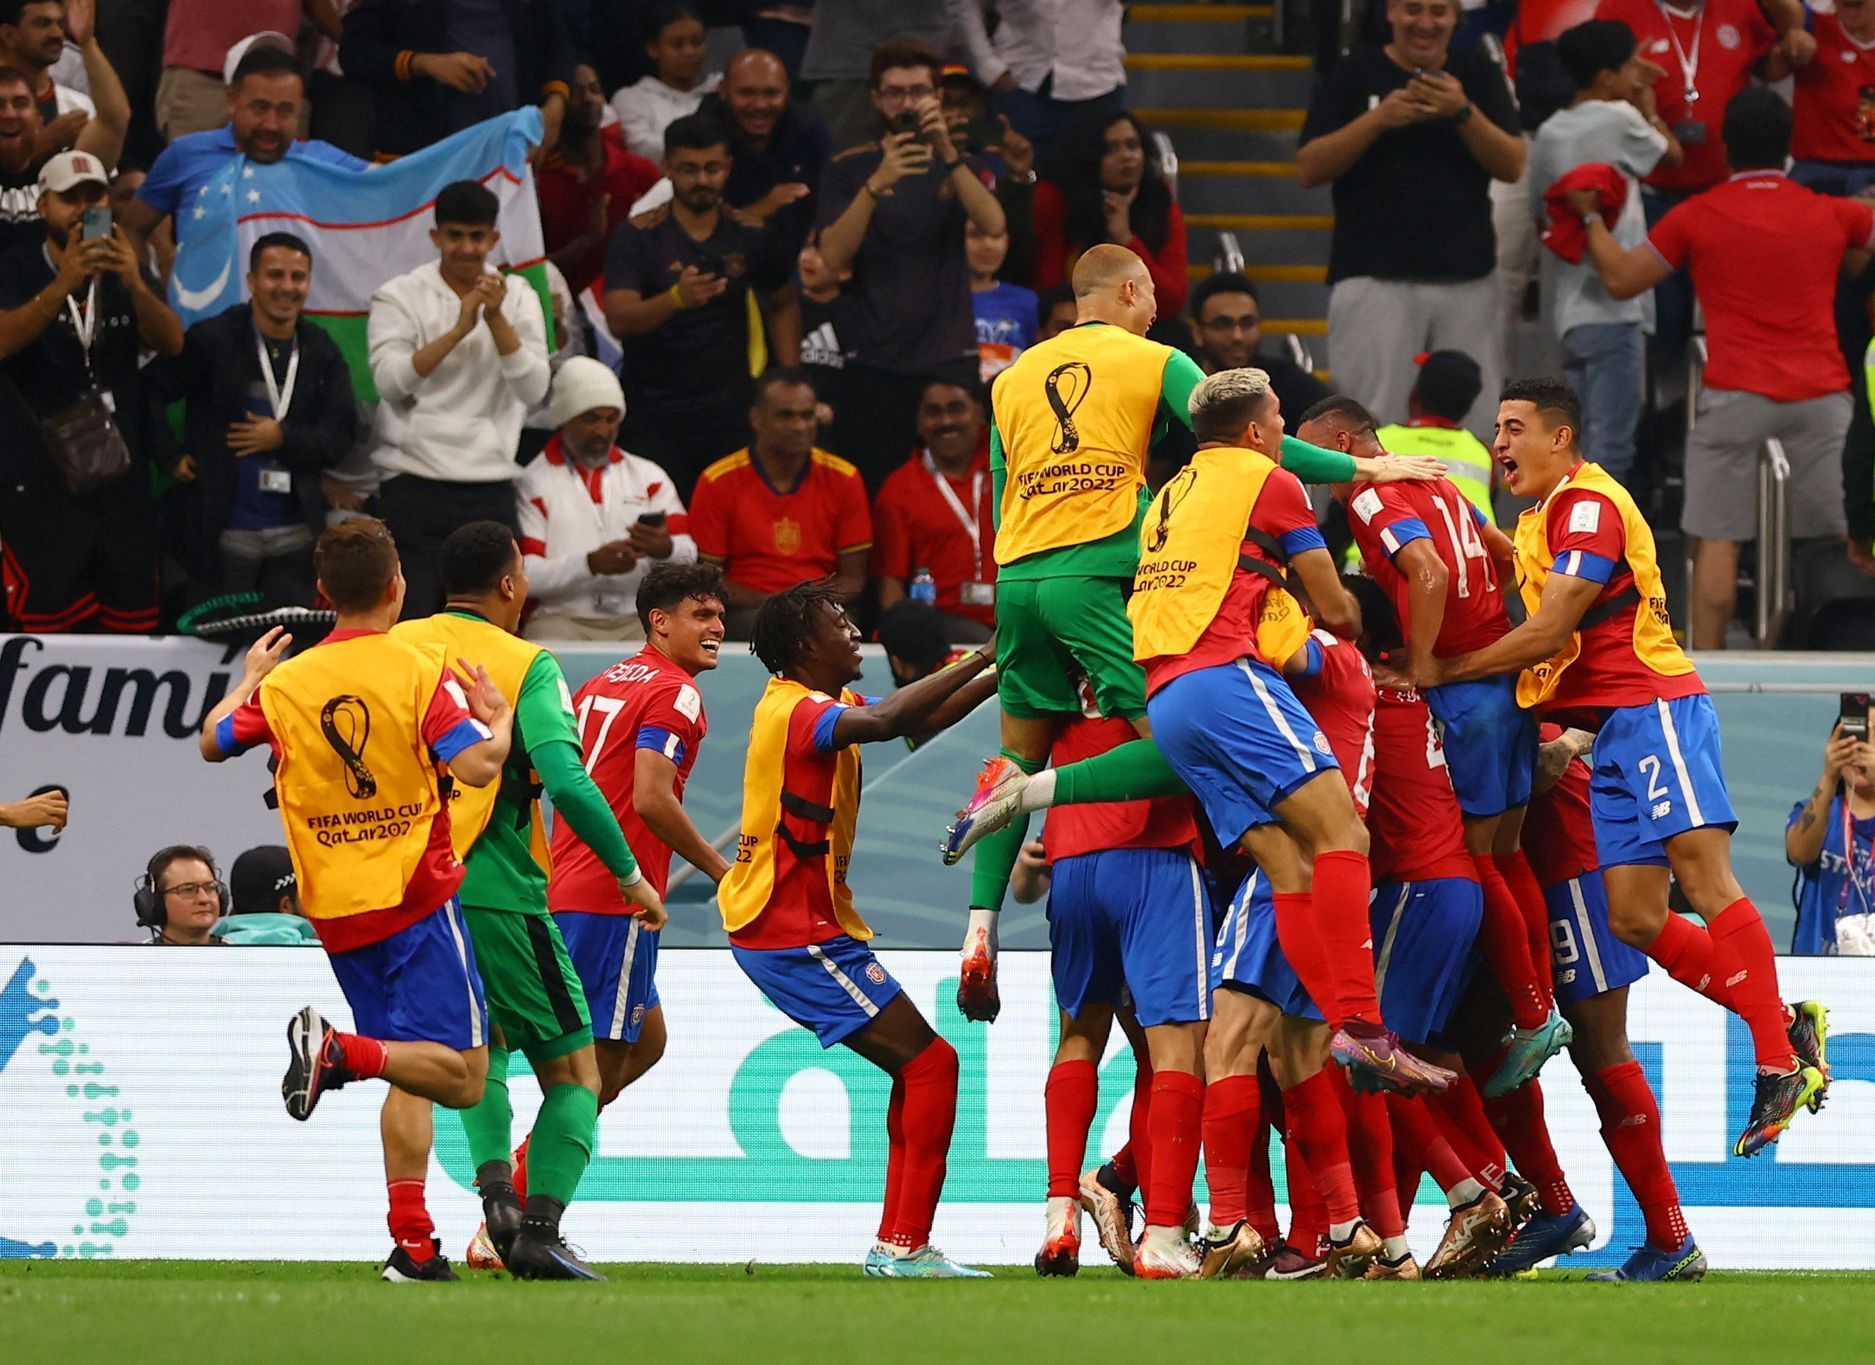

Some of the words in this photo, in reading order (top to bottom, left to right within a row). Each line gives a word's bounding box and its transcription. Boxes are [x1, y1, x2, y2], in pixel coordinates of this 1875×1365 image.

[1095, 464, 1126, 477] CUP
[1431, 494, 1497, 599] 14
[1171, 560, 1197, 573] CUP
[577, 694, 627, 775] 17
[1639, 755, 1668, 801] 2
[307, 815, 341, 829] FIFA
[343, 808, 395, 825] WORLD
[400, 803, 422, 817] CU
[316, 821, 411, 848] Qatar202
[1549, 919, 1580, 966] 9
[1667, 1250, 1700, 1278] balance
